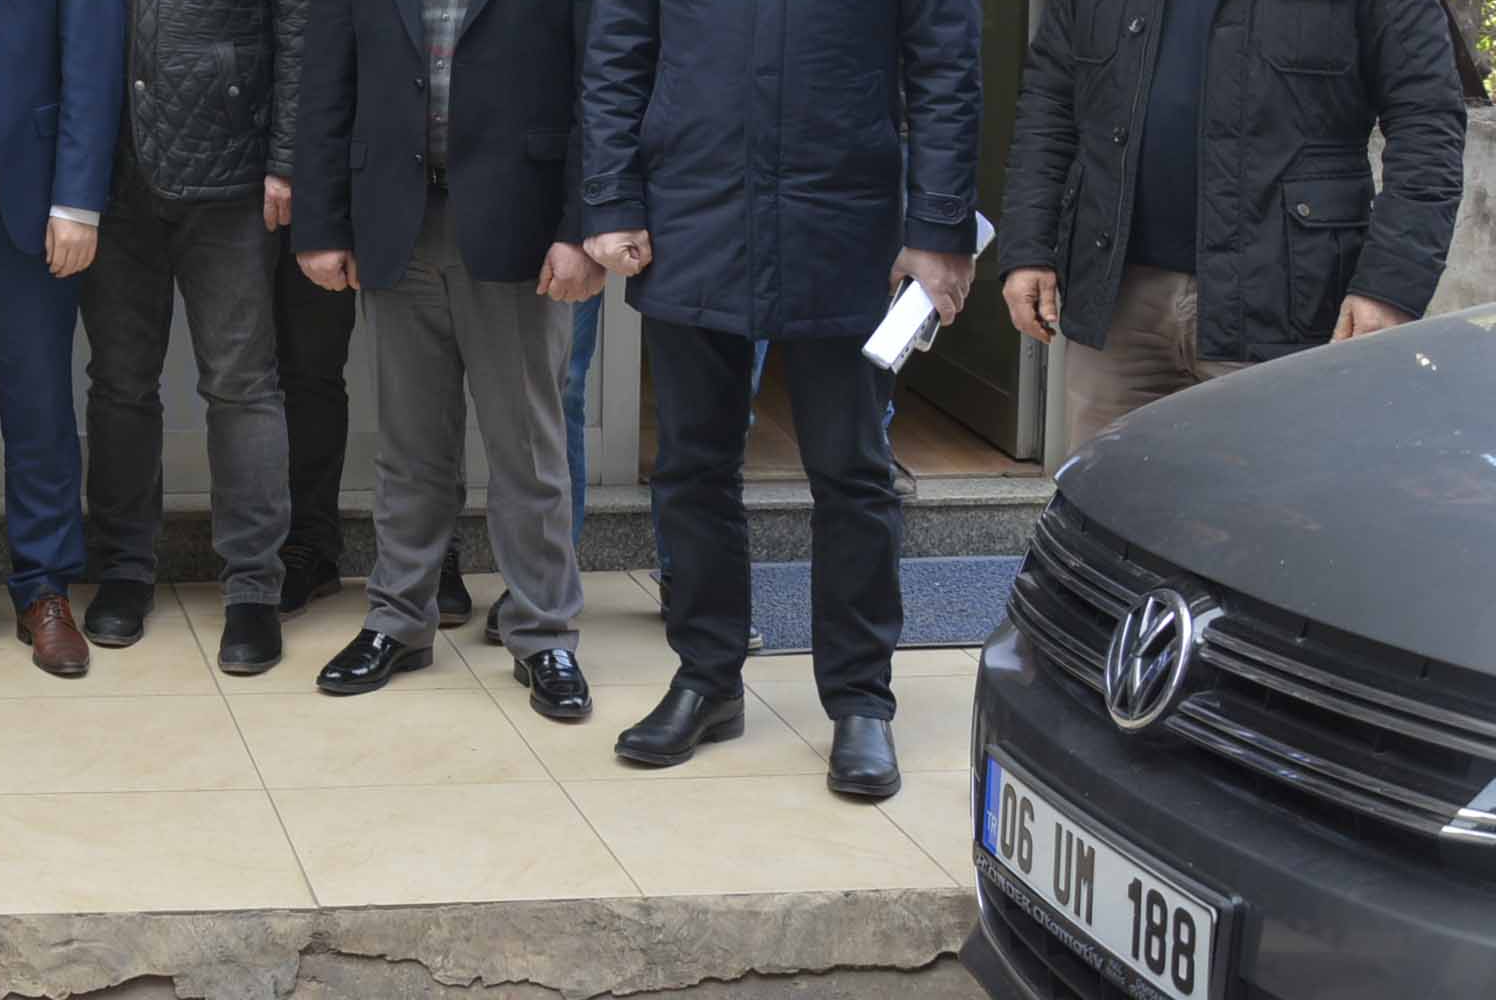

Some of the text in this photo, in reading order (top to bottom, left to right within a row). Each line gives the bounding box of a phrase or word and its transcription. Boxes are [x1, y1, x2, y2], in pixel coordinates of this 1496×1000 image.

[986, 809, 999, 834] TR
[1000, 782, 1197, 996] 06 UM 188
